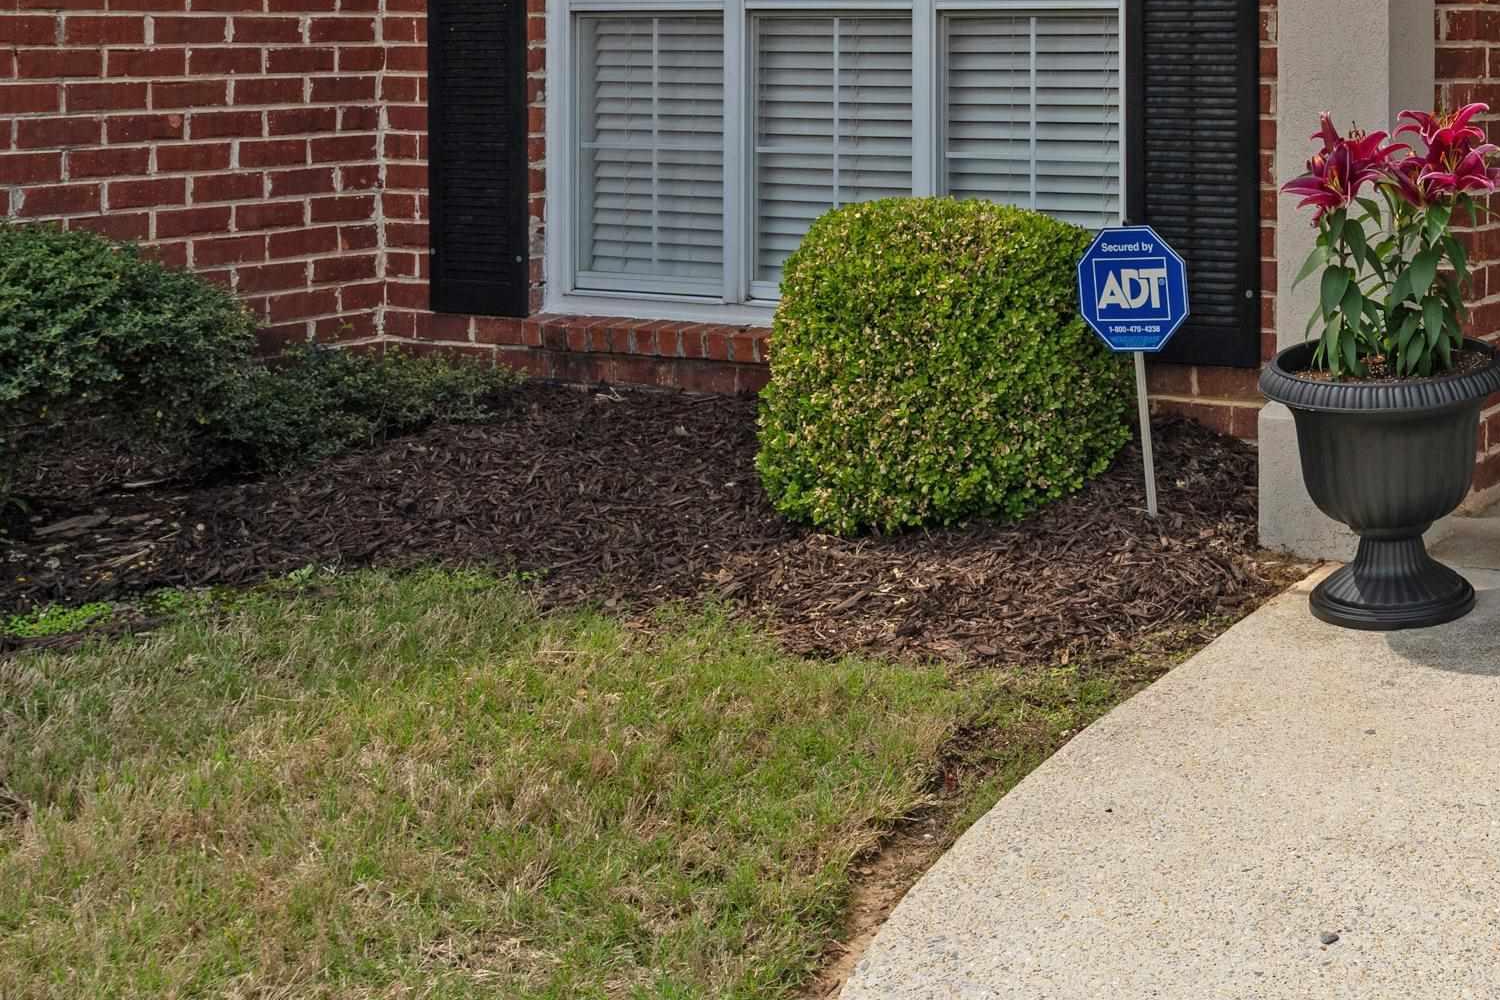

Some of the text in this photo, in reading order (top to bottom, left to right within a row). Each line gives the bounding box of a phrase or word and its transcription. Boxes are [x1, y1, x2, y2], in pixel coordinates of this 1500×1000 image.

[1101, 241, 1154, 253] Secured by
[1098, 268, 1167, 309] ADT
